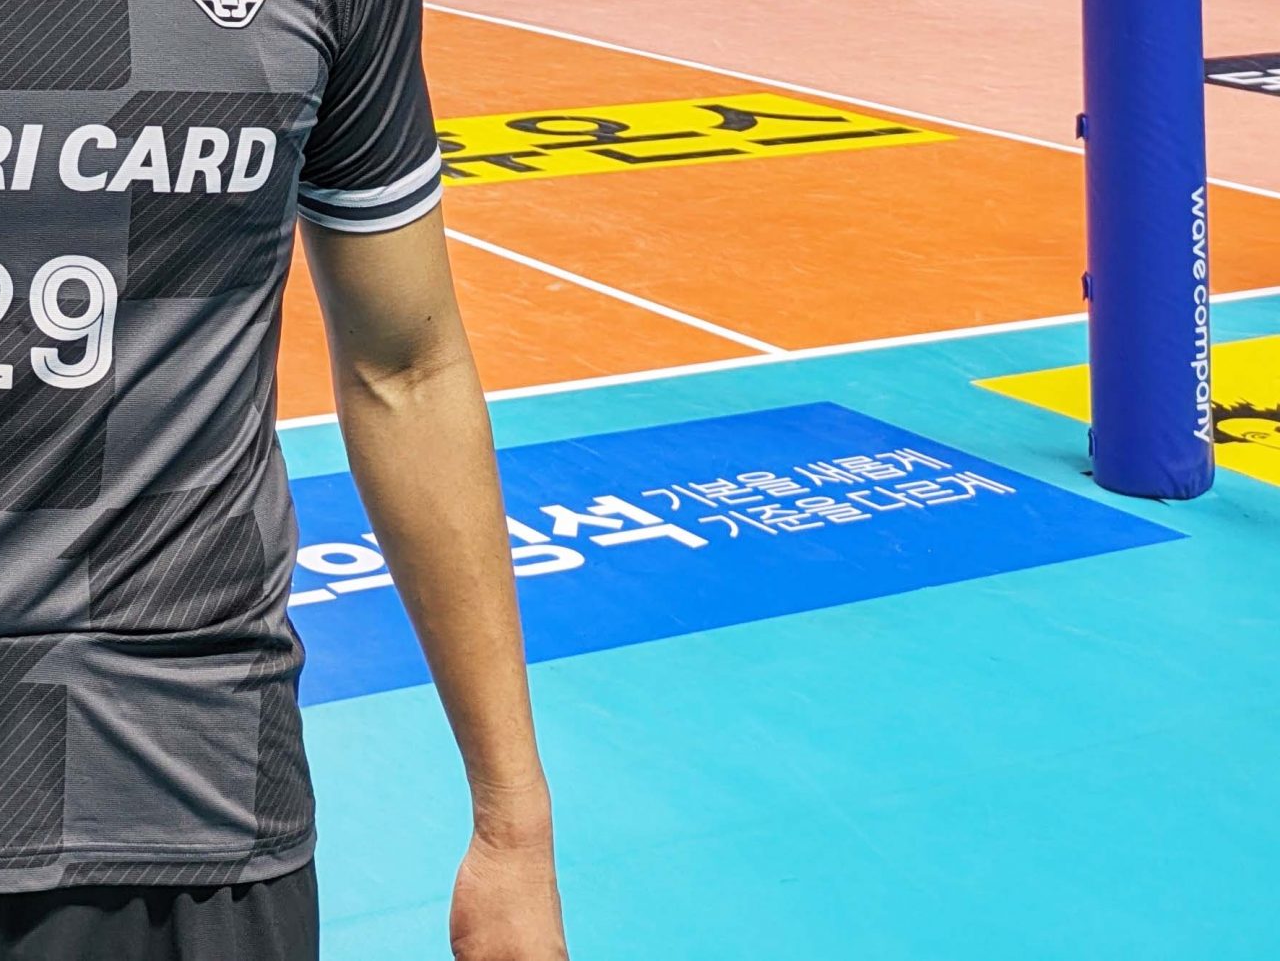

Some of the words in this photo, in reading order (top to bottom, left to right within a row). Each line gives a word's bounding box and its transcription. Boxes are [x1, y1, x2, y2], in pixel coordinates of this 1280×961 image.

[58, 124, 278, 193] CARD
[1191, 185, 1207, 280] wave
[1190, 284, 1211, 444] company
[642, 470, 811, 511] 기본을
[793, 447, 953, 487] 새롭게
[697, 496, 873, 538] 기준을
[845, 471, 1017, 510] 다르게
